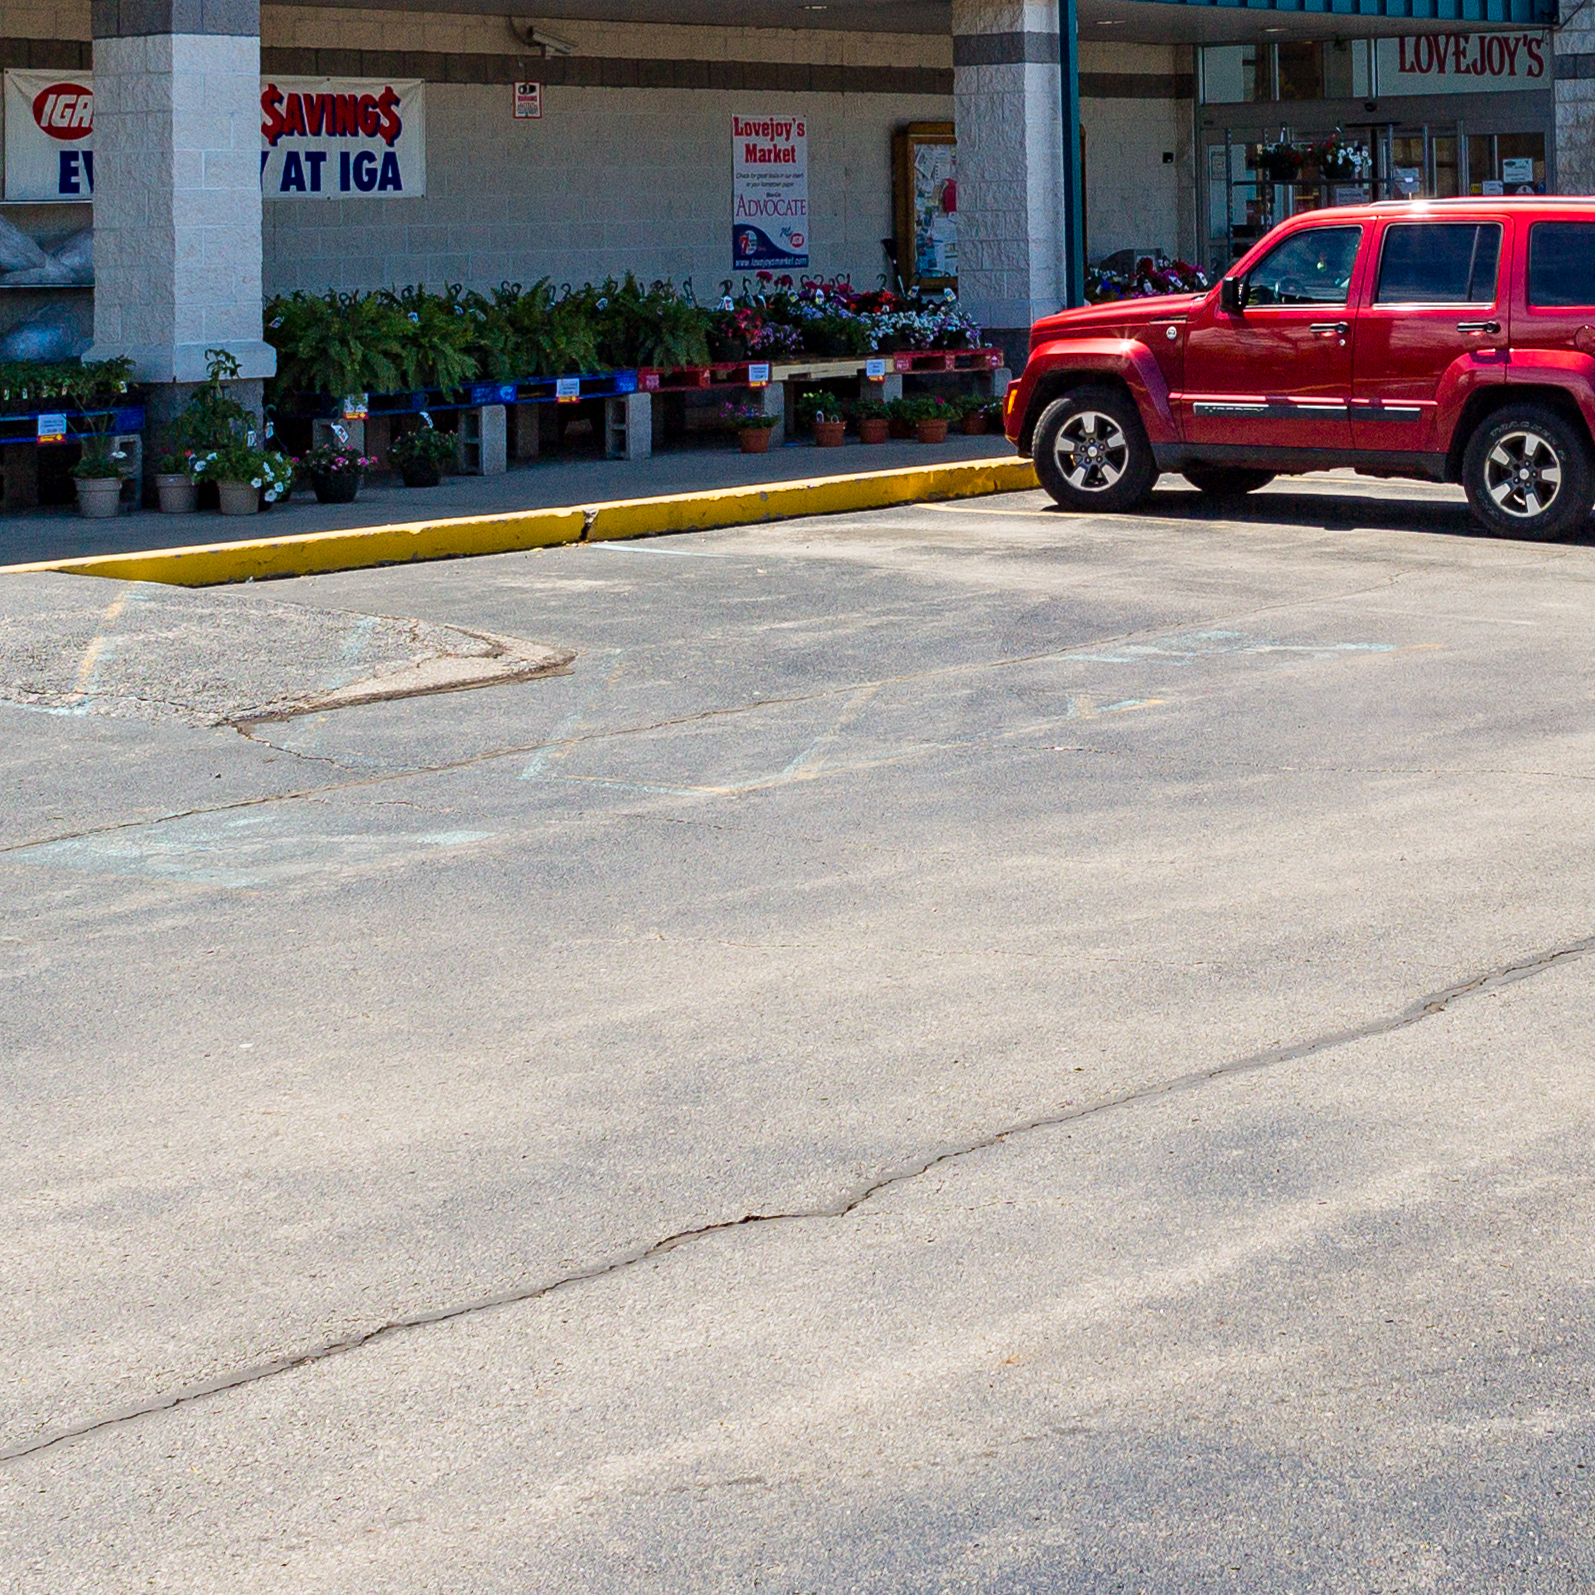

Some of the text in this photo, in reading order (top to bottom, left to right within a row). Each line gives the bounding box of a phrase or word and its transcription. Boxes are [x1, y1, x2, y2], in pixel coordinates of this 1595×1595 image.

[1398, 33, 1544, 78] LOVEJOY'S
[40, 93, 94, 128] IGA
[732, 116, 806, 143] Lovejoy's
[744, 143, 797, 164] Market
[280, 150, 327, 192] AT
[339, 150, 403, 192] IGA
[735, 193, 806, 217] ADVOCATE
